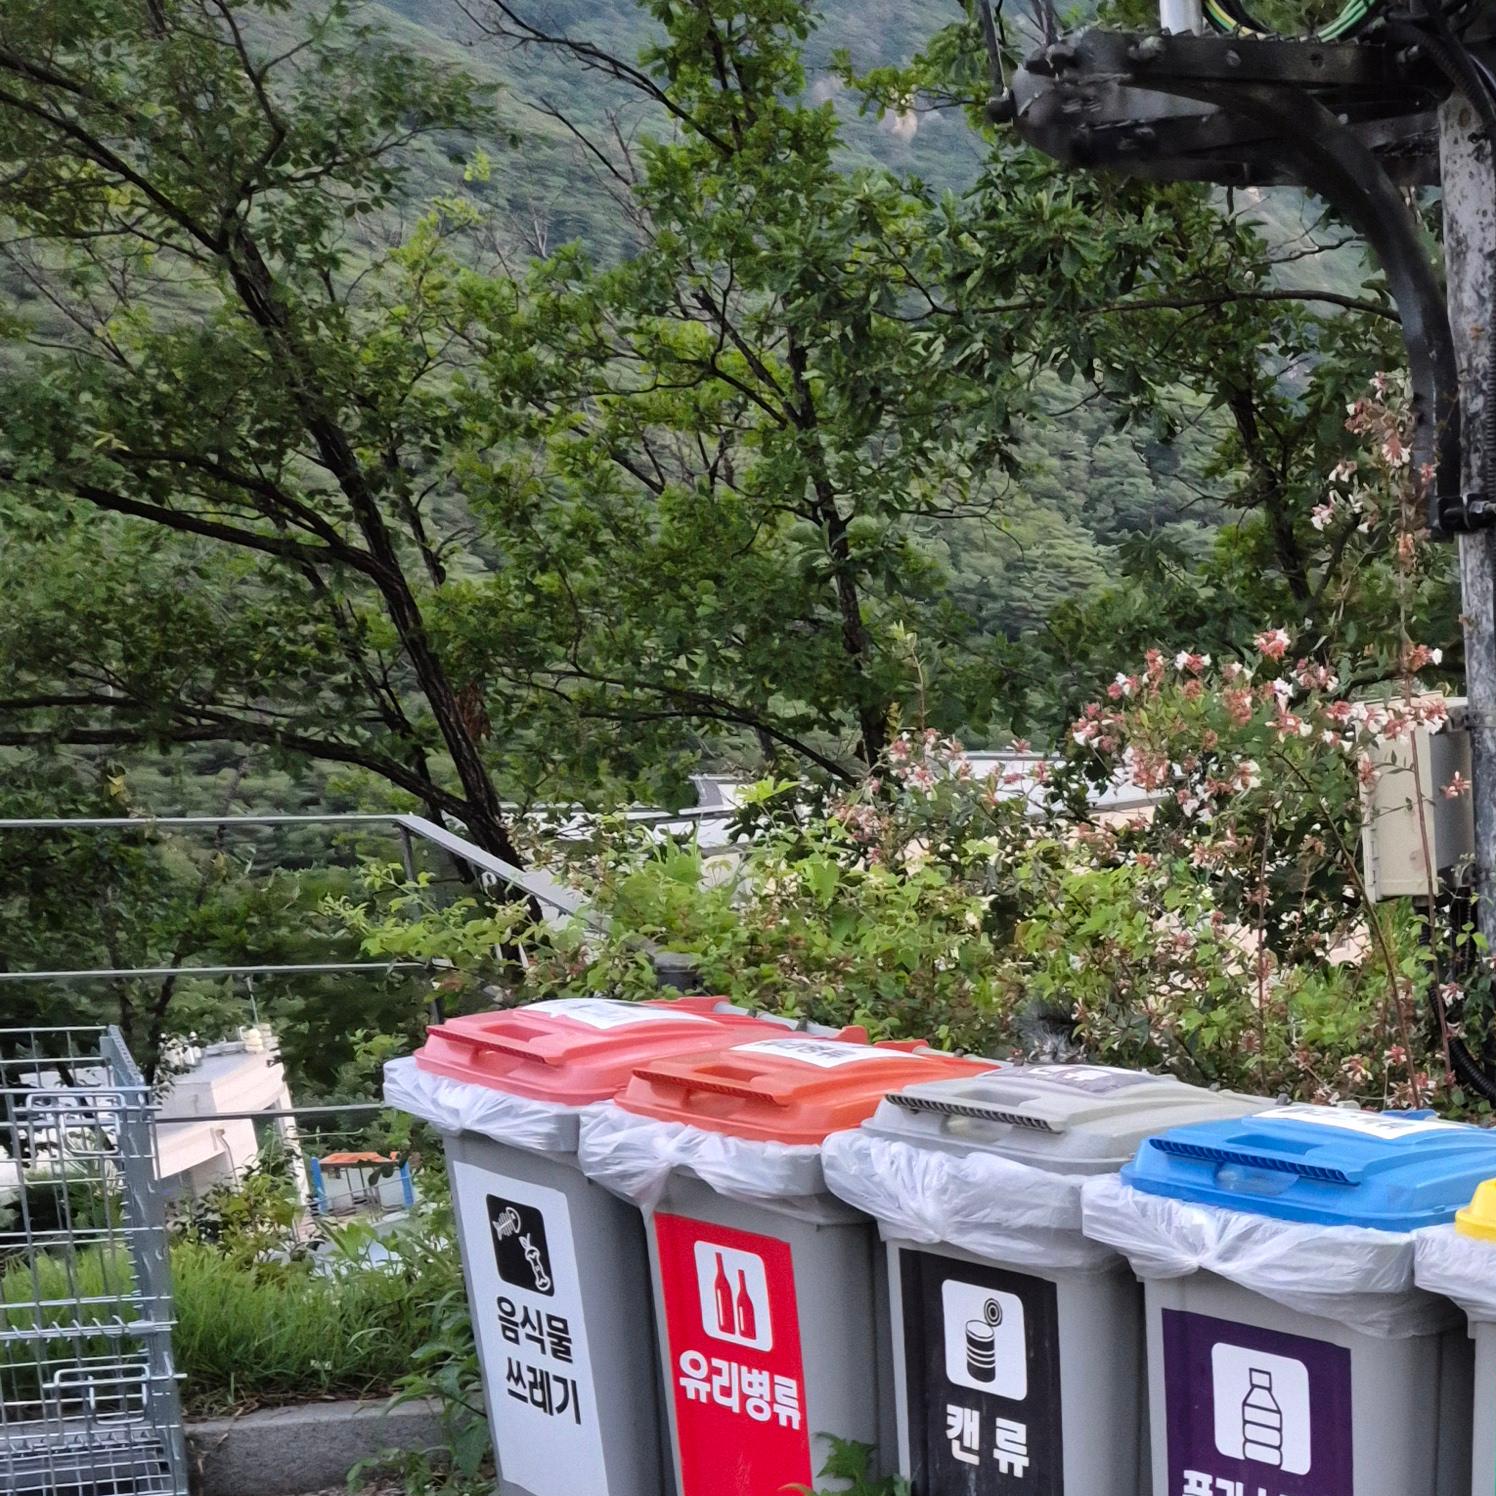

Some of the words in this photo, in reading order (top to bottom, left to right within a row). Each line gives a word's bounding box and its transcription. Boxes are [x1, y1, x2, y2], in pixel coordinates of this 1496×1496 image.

[497, 1296, 573, 1364] 음식물
[506, 1357, 581, 1425] 쓰레기
[679, 1350, 800, 1430] 유리병류
[946, 1404, 980, 1466] 캔
[993, 1417, 1029, 1478] 류
